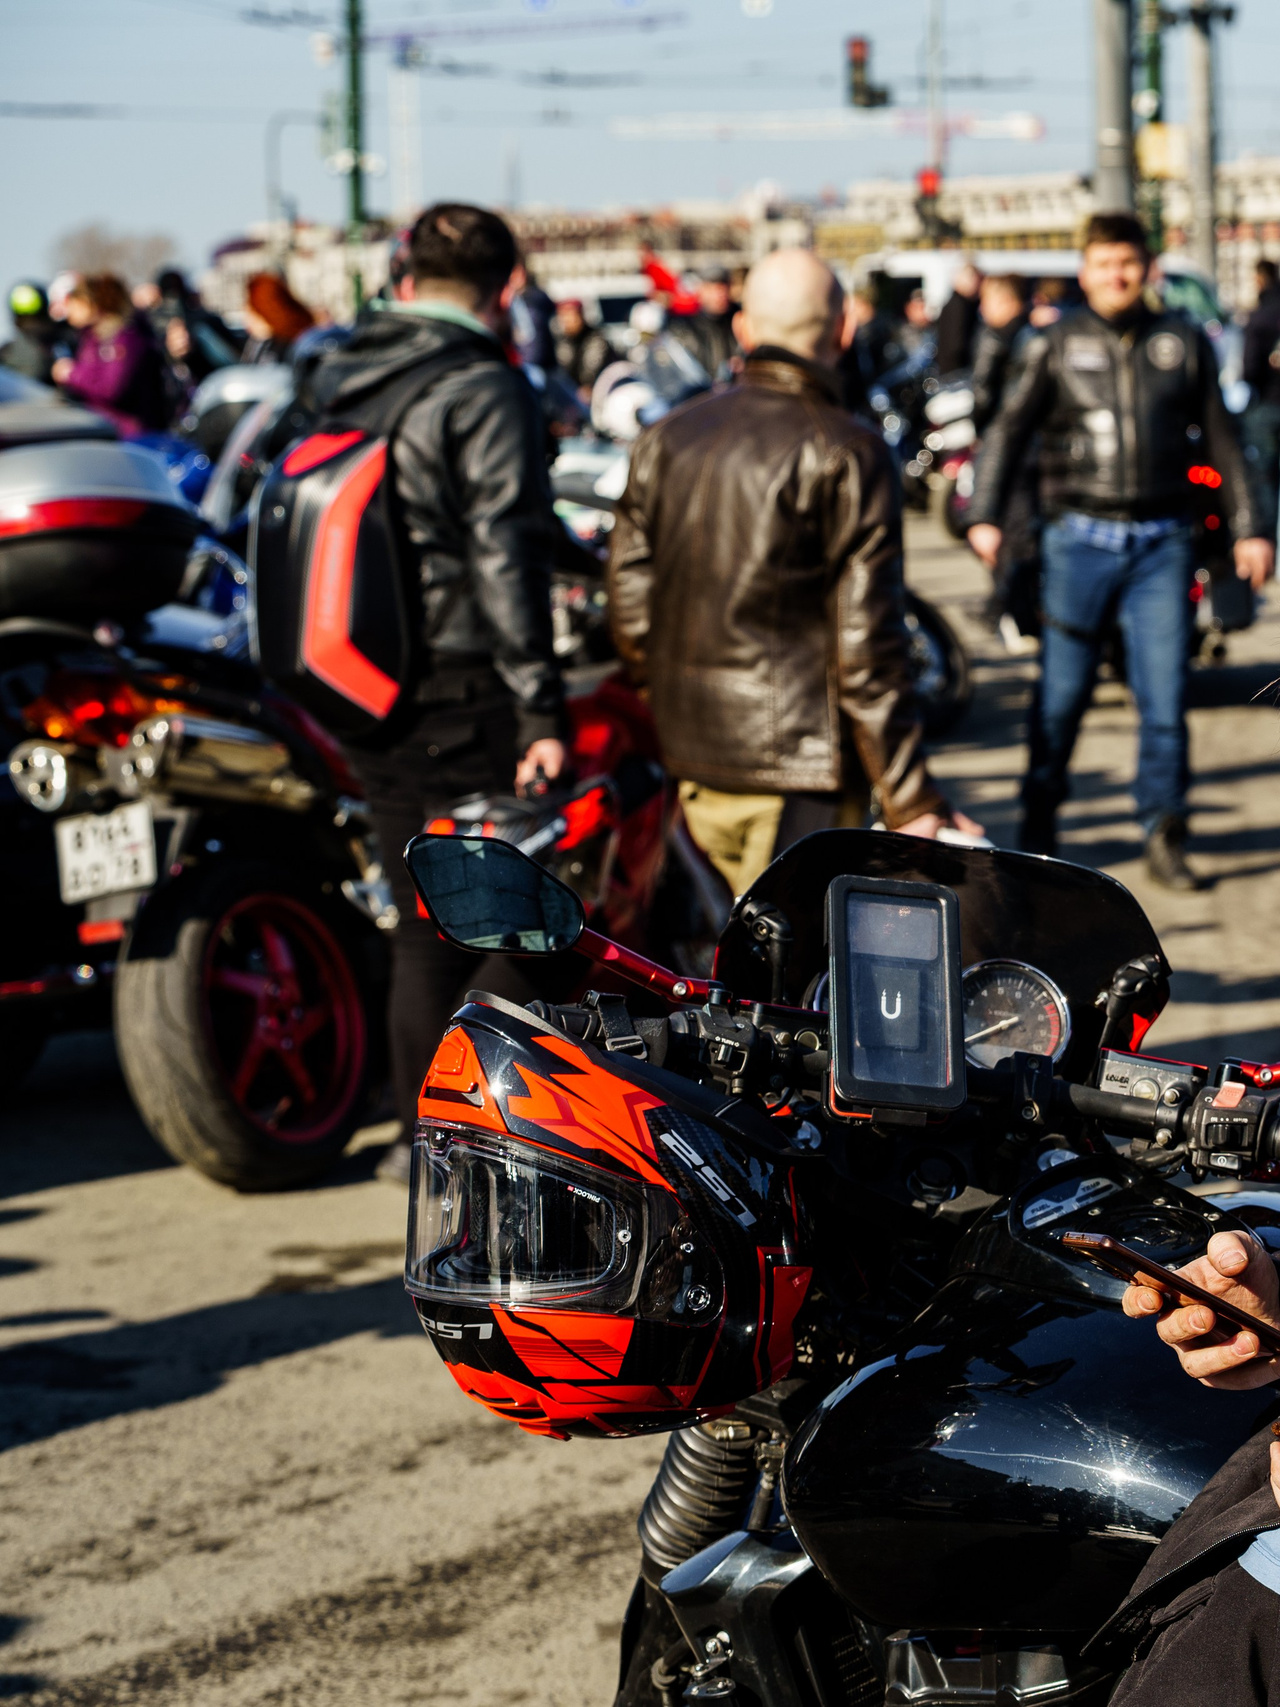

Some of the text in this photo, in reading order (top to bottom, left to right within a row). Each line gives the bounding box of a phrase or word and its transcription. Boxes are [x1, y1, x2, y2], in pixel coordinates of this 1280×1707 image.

[721, 1037, 735, 1046] TURN
[1105, 1073, 1130, 1085] LOWER
[573, 1187, 601, 1203] PINLOCK
[1030, 1203, 1050, 1214] FUEL
